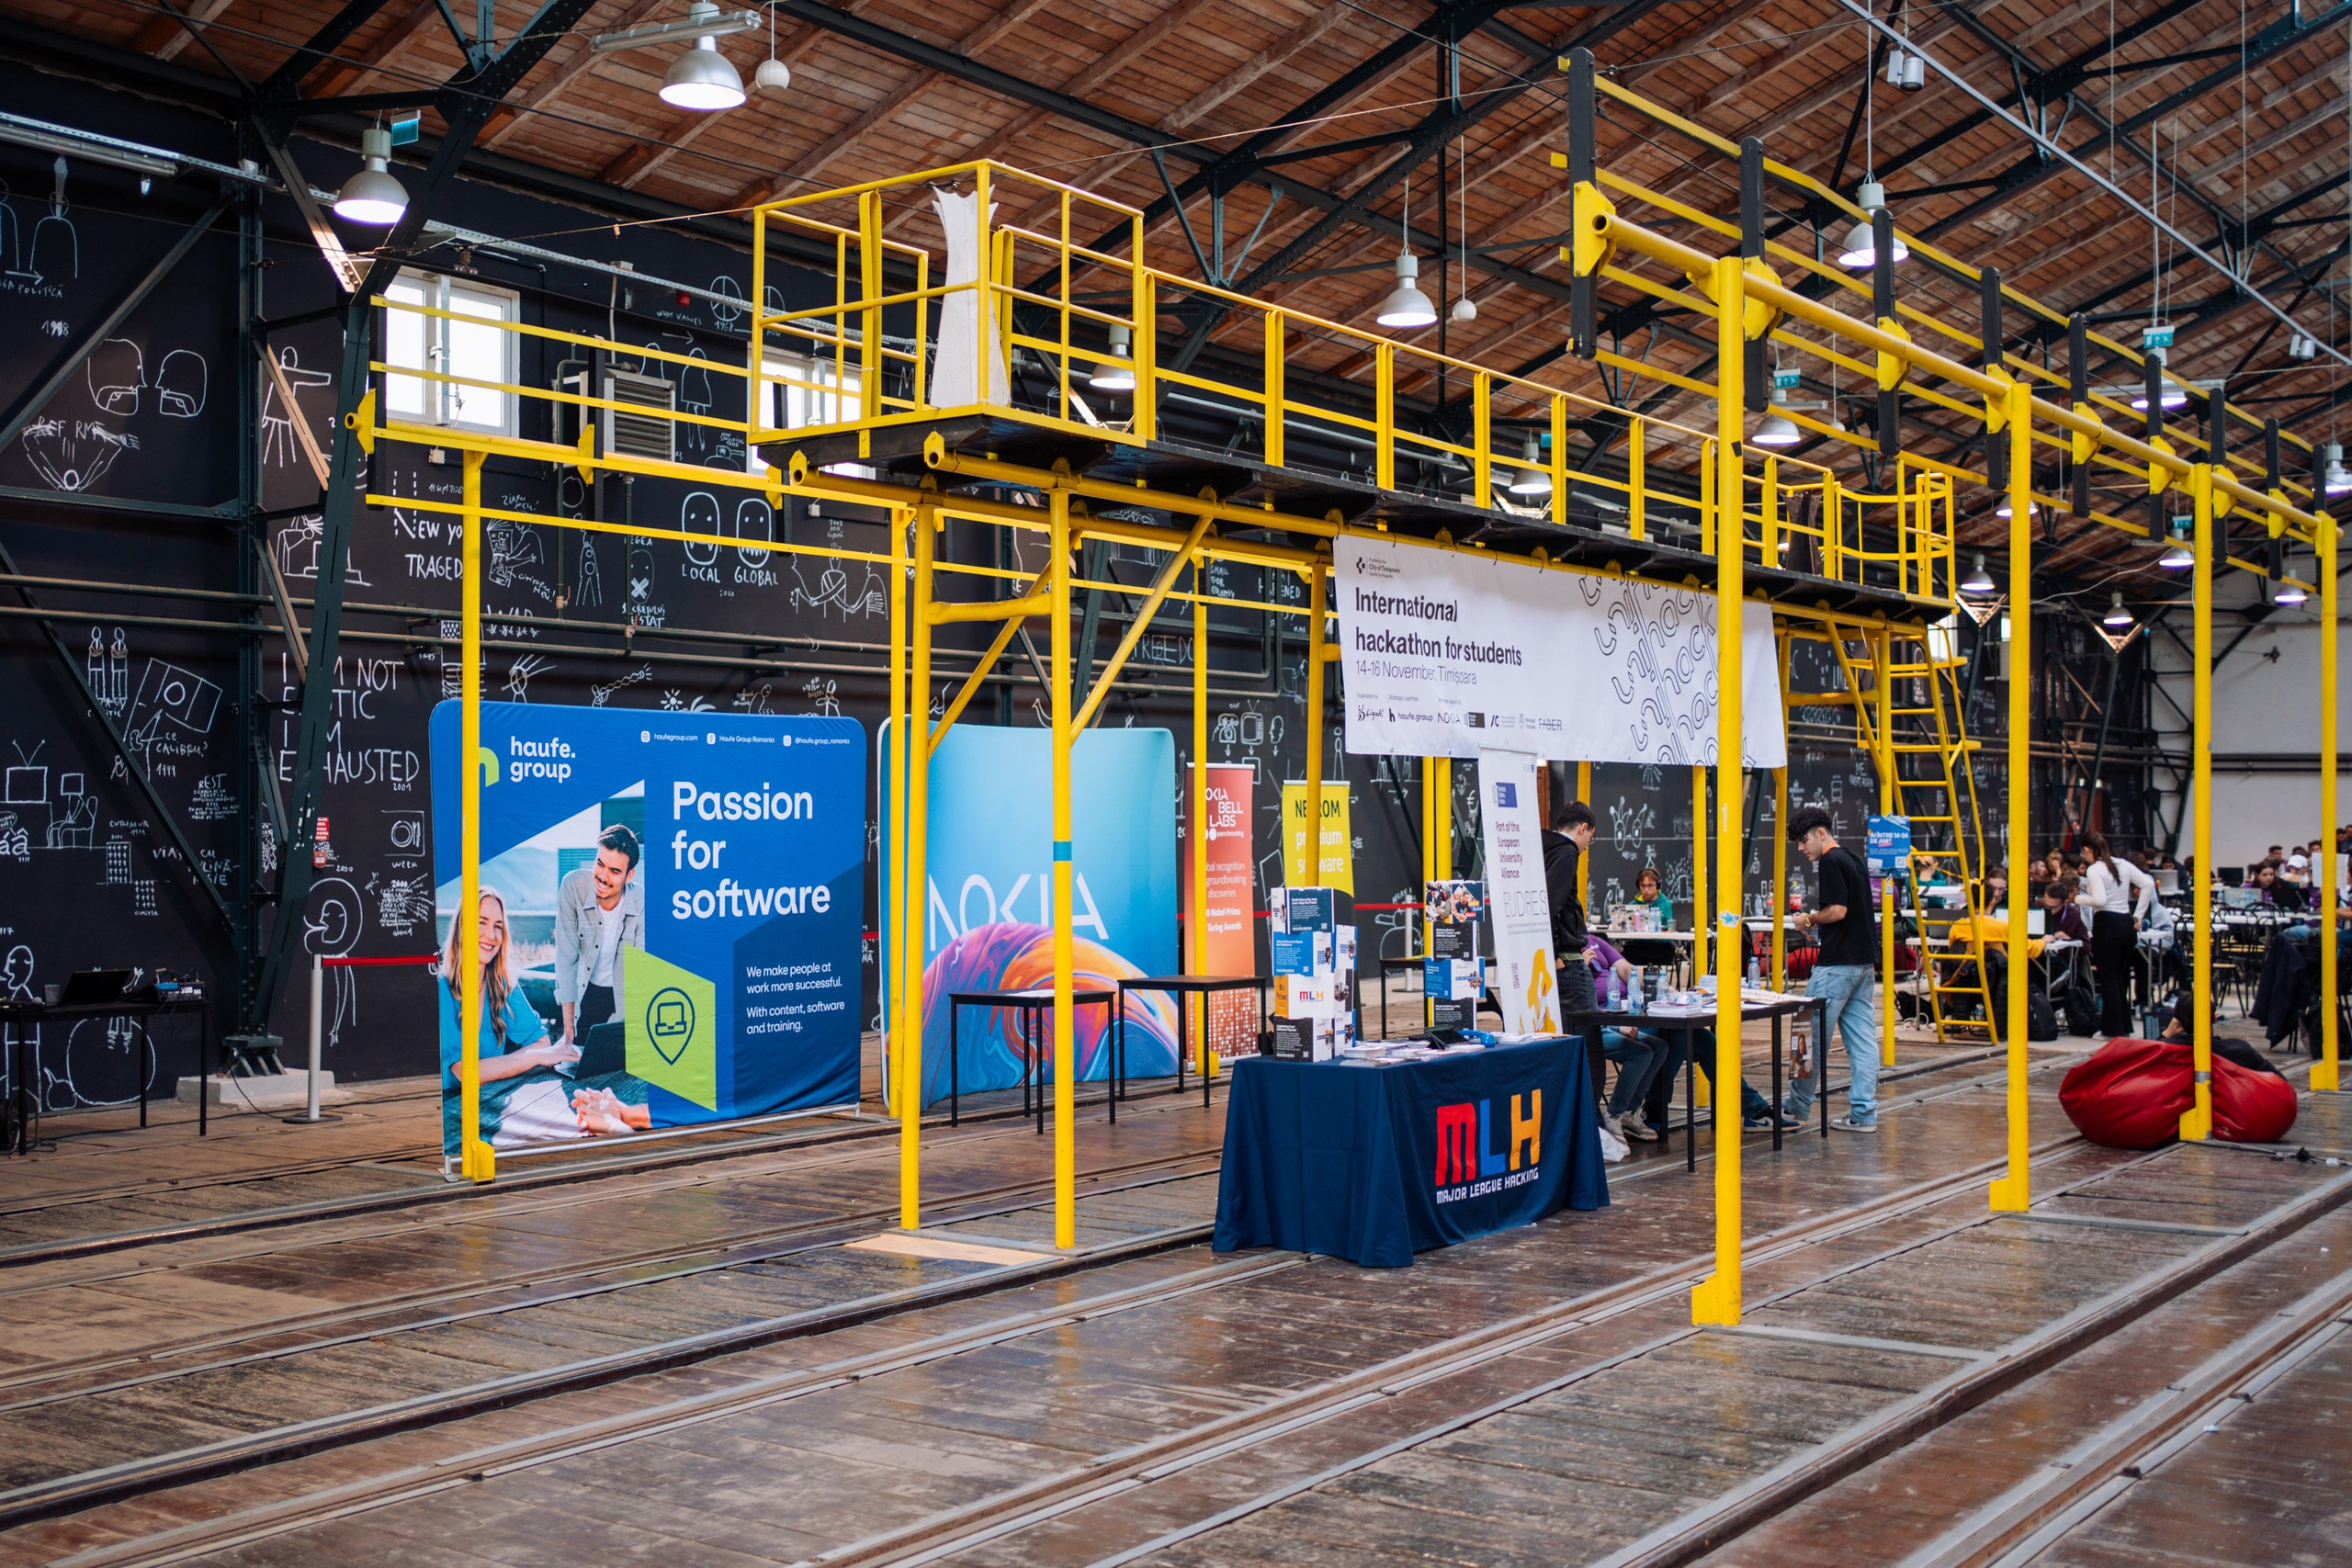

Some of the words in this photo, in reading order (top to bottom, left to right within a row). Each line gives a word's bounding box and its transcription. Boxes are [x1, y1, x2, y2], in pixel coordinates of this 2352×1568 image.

[714, 321, 735, 333] 1968
[448, 485, 464, 495] 200
[447, 521, 464, 546] YO
[625, 536, 653, 547] EGEA
[404, 553, 464, 582] TRAGED
[682, 563, 720, 584] LOCAL
[734, 565, 779, 587] GLOBAL
[1355, 587, 1458, 623] International
[1355, 626, 1442, 658] hackathon
[1445, 636, 1462, 660] for
[1464, 641, 1522, 666] students
[357, 658, 405, 692] NOT
[1356, 660, 1381, 677] 14-16
[1383, 660, 1438, 682] November,
[282, 685, 376, 720] ETIC
[511, 736, 577, 759] haufe.
[653, 733, 698, 742] haufegroup.com
[718, 735, 735, 743] Haufe
[735, 736, 752, 745] Group
[279, 749, 420, 785] EHAUSTED
[510, 762, 571, 784] group
[198, 773, 228, 790] REST
[673, 781, 813, 821] Passion
[1205, 787, 1228, 801] OKIA
[1218, 802, 1244, 814] BELL
[1295, 799, 1341, 818] NEOM
[1209, 815, 1237, 828] LABS
[1496, 820, 1505, 832] Part
[1511, 821, 1520, 832] the
[1296, 827, 1343, 852] prium
[1497, 837, 1520, 852] European
[672, 829, 727, 870] for
[1498, 851, 1523, 866] University
[391, 861, 418, 869] WEEK
[1216, 861, 1245, 874] recognition
[1297, 856, 1344, 874] soware
[1501, 867, 1520, 879] Alliance
[672, 878, 831, 920] software
[1207, 888, 1237, 898] discoveries
[929, 871, 1109, 952] NOKIA
[1211, 907, 1226, 917] Nobel
[1226, 906, 1241, 916] Prizes
[1206, 921, 1224, 934] Turing
[1224, 920, 1242, 931] Awards
[746, 965, 762, 977] We
[763, 964, 788, 976] make
[789, 962, 820, 977] people
[821, 962, 831, 973] at
[746, 981, 770, 994] work
[771, 982, 794, 992] more
[795, 976, 842, 990] successful.
[746, 1006, 767, 1019] With
[768, 1003, 806, 1017] content,
[807, 1000, 845, 1013] software
[746, 1022, 766, 1034] and
[766, 1020, 803, 1033] training.
[1435, 1089, 1542, 1187] MLH
[1436, 1186, 1467, 1204] MAJOR
[1470, 1178, 1502, 1198] LEAGUE
[1504, 1167, 1539, 1190] HACKING
